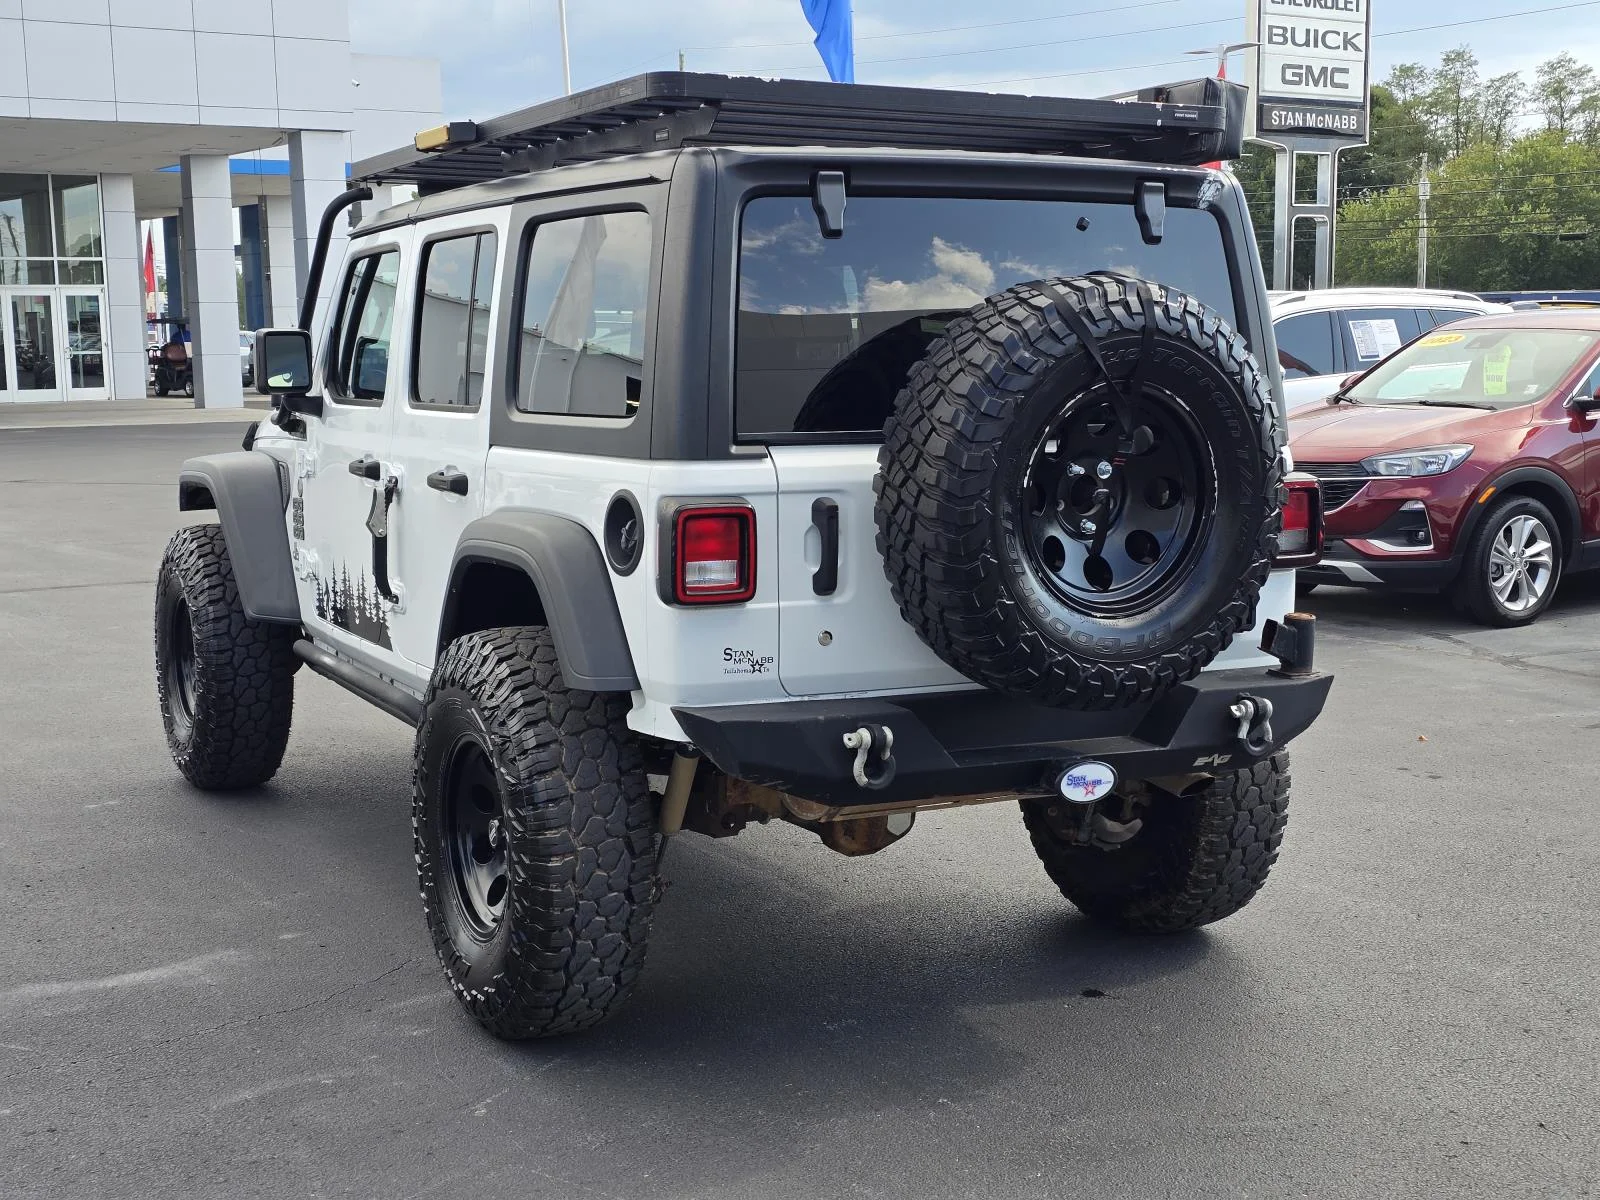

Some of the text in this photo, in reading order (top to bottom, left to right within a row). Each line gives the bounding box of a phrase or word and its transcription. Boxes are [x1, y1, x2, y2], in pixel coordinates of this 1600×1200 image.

[1271, 0, 1360, 13] ROLET
[1267, 24, 1363, 52] BUICK
[1281, 63, 1350, 90] GMC
[1271, 110, 1357, 130] STAN McNABB
